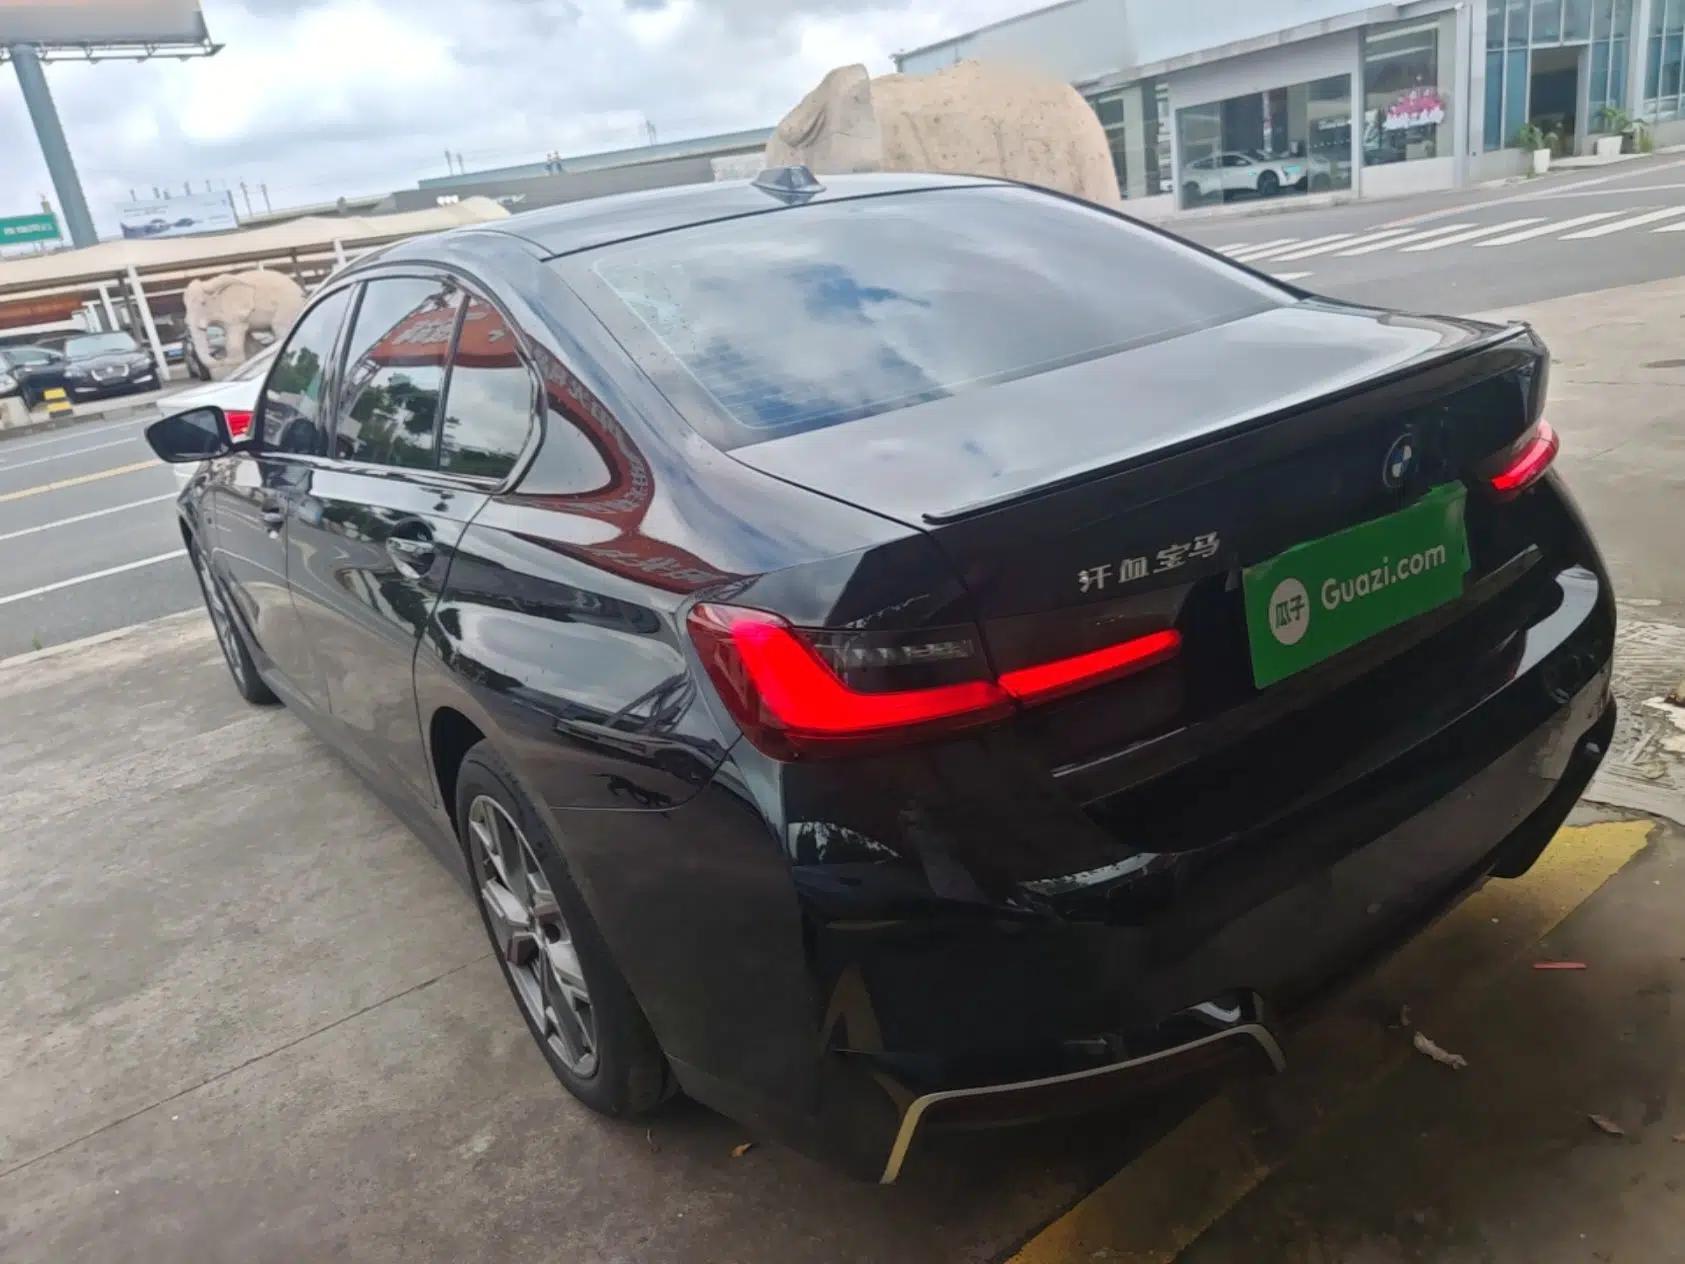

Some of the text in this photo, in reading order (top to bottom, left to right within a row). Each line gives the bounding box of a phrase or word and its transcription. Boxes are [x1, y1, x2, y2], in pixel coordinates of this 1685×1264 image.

[1077, 531, 1220, 593] 汗血宝马
[1320, 543, 1447, 610] Guazi.com
[1275, 594, 1305, 629] 瓜子
